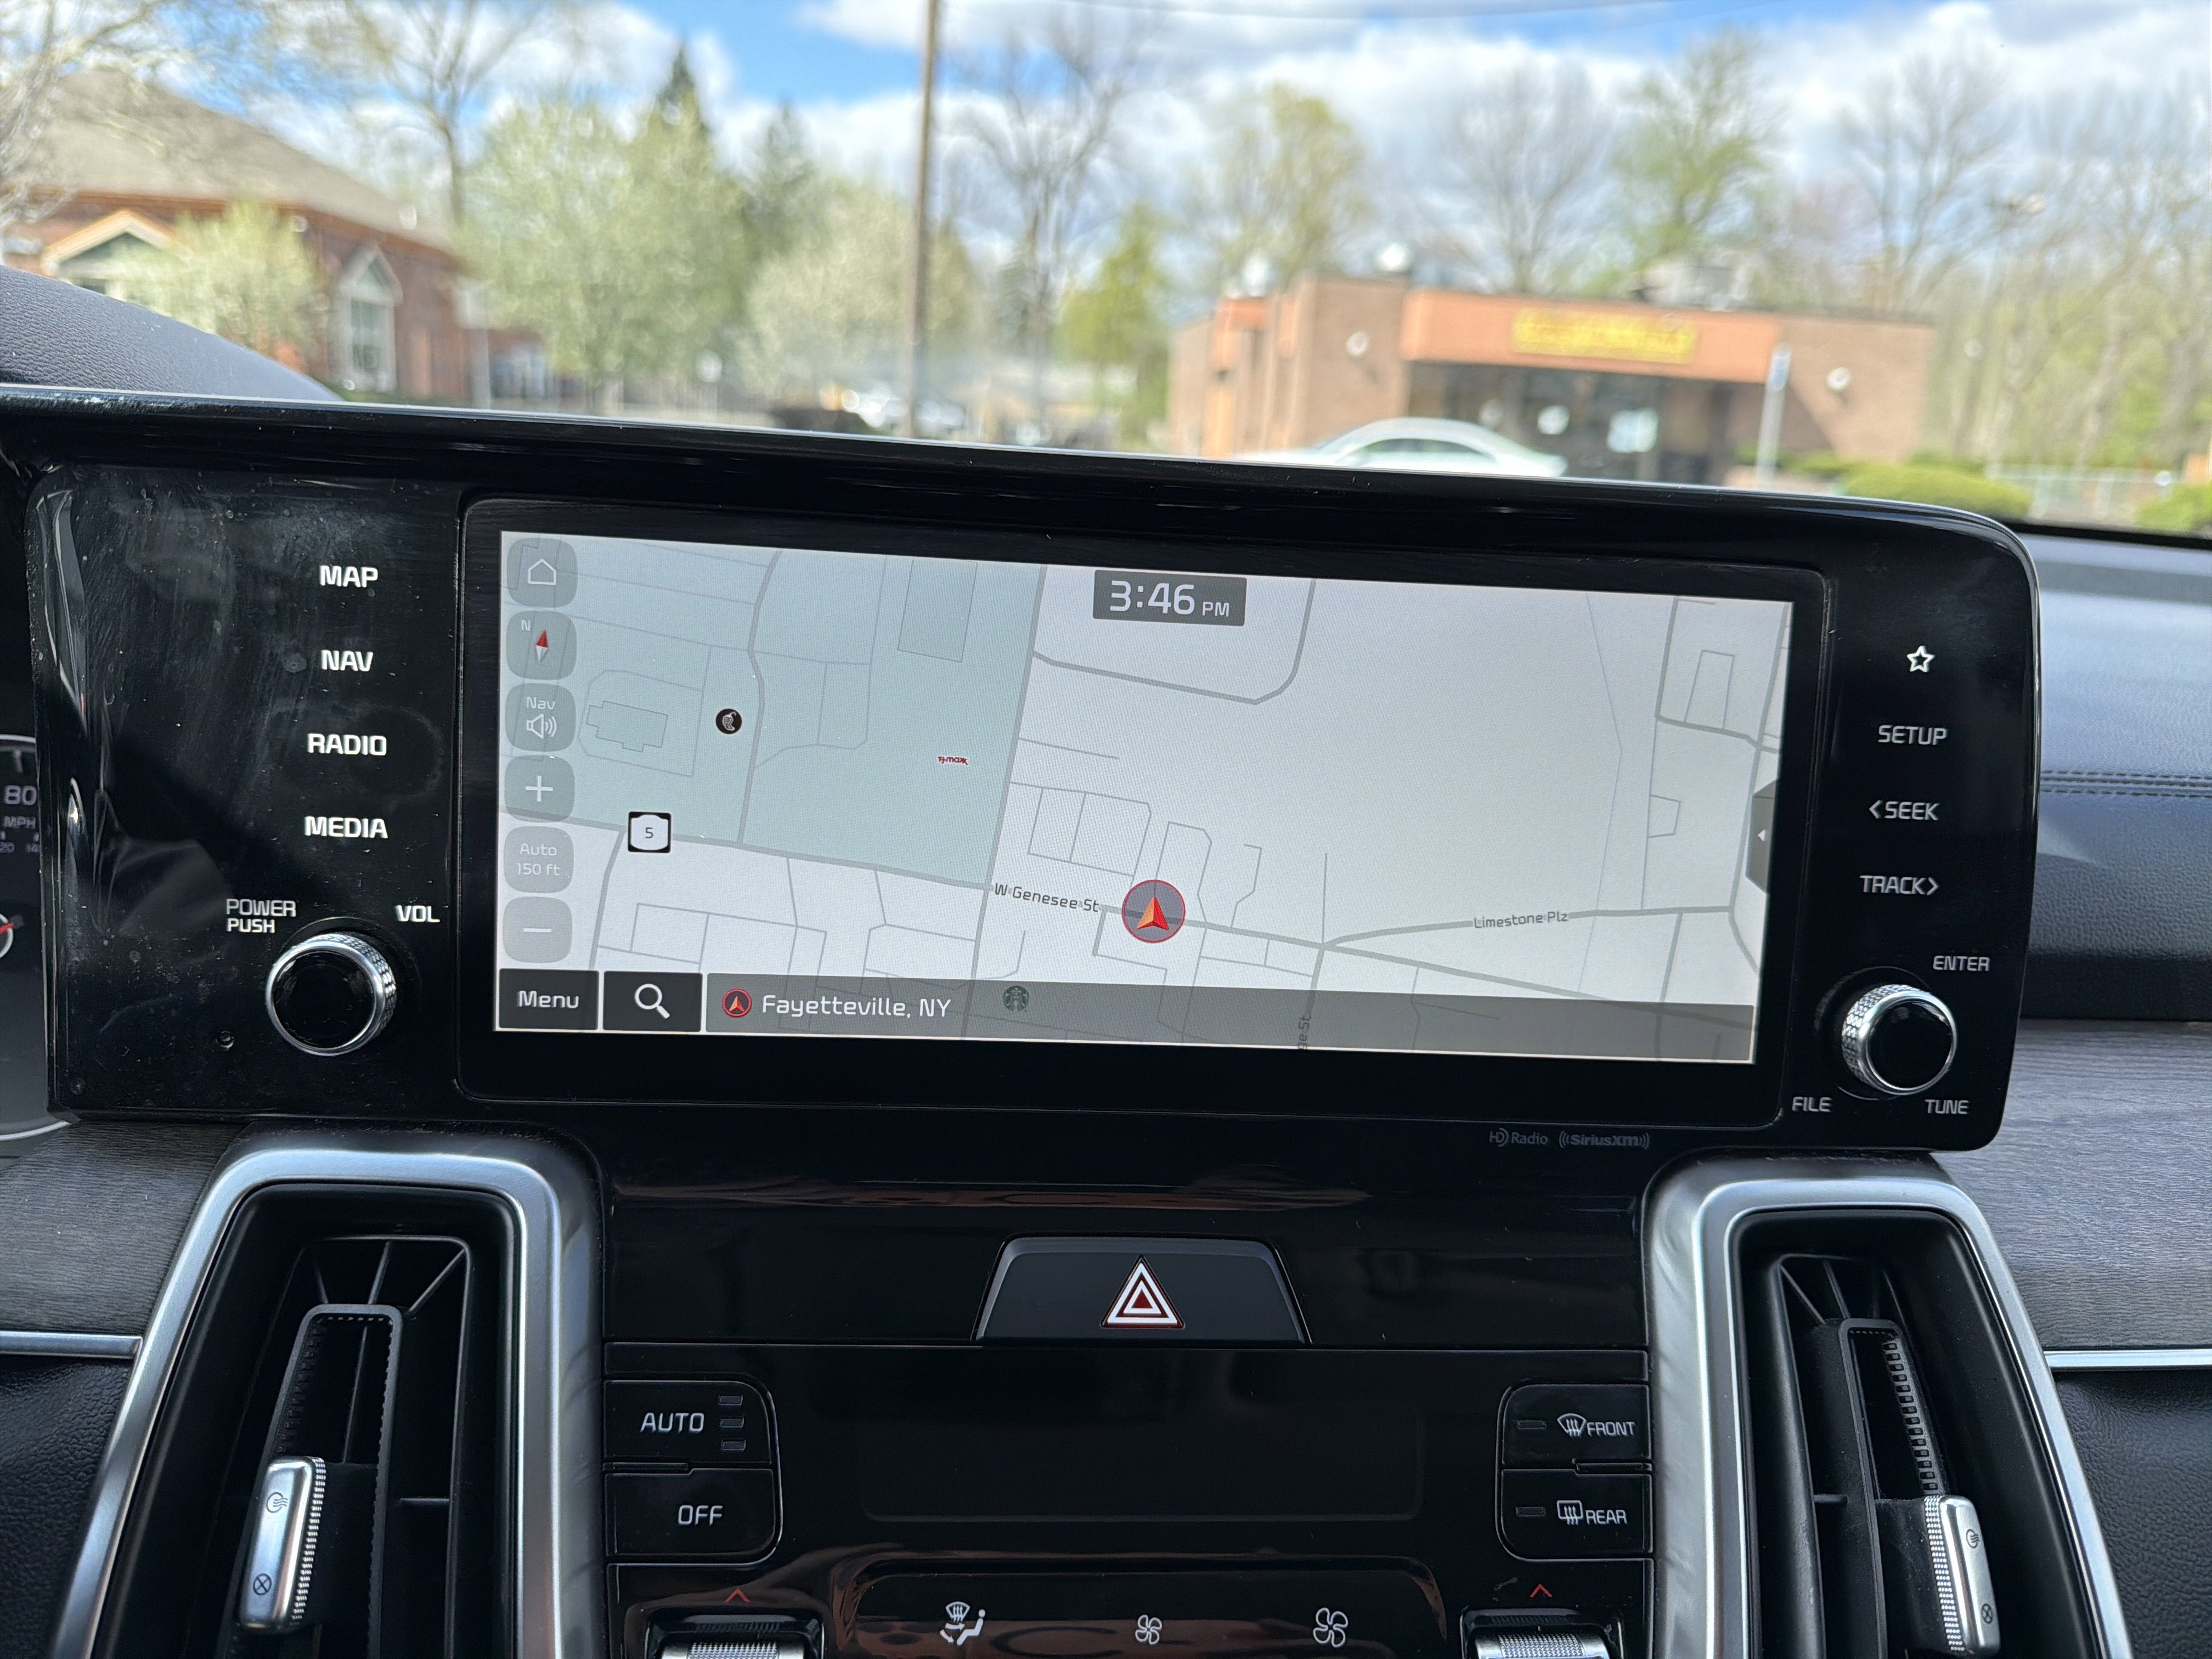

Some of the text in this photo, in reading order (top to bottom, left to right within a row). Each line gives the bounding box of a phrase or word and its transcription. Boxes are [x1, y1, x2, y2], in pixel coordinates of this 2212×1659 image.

[319, 565, 379, 588] MAP
[1109, 580, 1229, 617] 3:46 PM
[521, 620, 531, 631] N
[321, 650, 374, 672] NAV
[526, 696, 556, 710] Nav
[307, 733, 387, 756] RADIO
[1877, 725, 1948, 746] SETUP
[4, 785, 37, 806] 80
[1884, 801, 1940, 821] SEEK
[4, 815, 36, 830] MPH
[304, 816, 388, 839] MEDIA
[645, 827, 654, 839] 5
[520, 843, 557, 857] Auto
[517, 863, 560, 876] 150 ft
[1860, 875, 1925, 895] TRACK
[995, 883, 1100, 912] W Genesee St
[225, 898, 297, 918] POWER
[396, 905, 440, 923] VOL
[227, 918, 275, 934] PUSH
[1474, 911, 1568, 928] Limestone Plz
[1933, 955, 1990, 972] ENTER
[517, 990, 579, 1009] Menu
[762, 995, 951, 1019] Fayetteville, NY
[1792, 1097, 1832, 1112] FILE
[1925, 1099, 1970, 1115] TUNE
[1511, 1132, 1548, 1144] Radio
[640, 1412, 704, 1432] AUTO
[1587, 1421, 1635, 1436] FRONT
[678, 1505, 723, 1526] OFF
[1585, 1509, 1627, 1525] REAR
